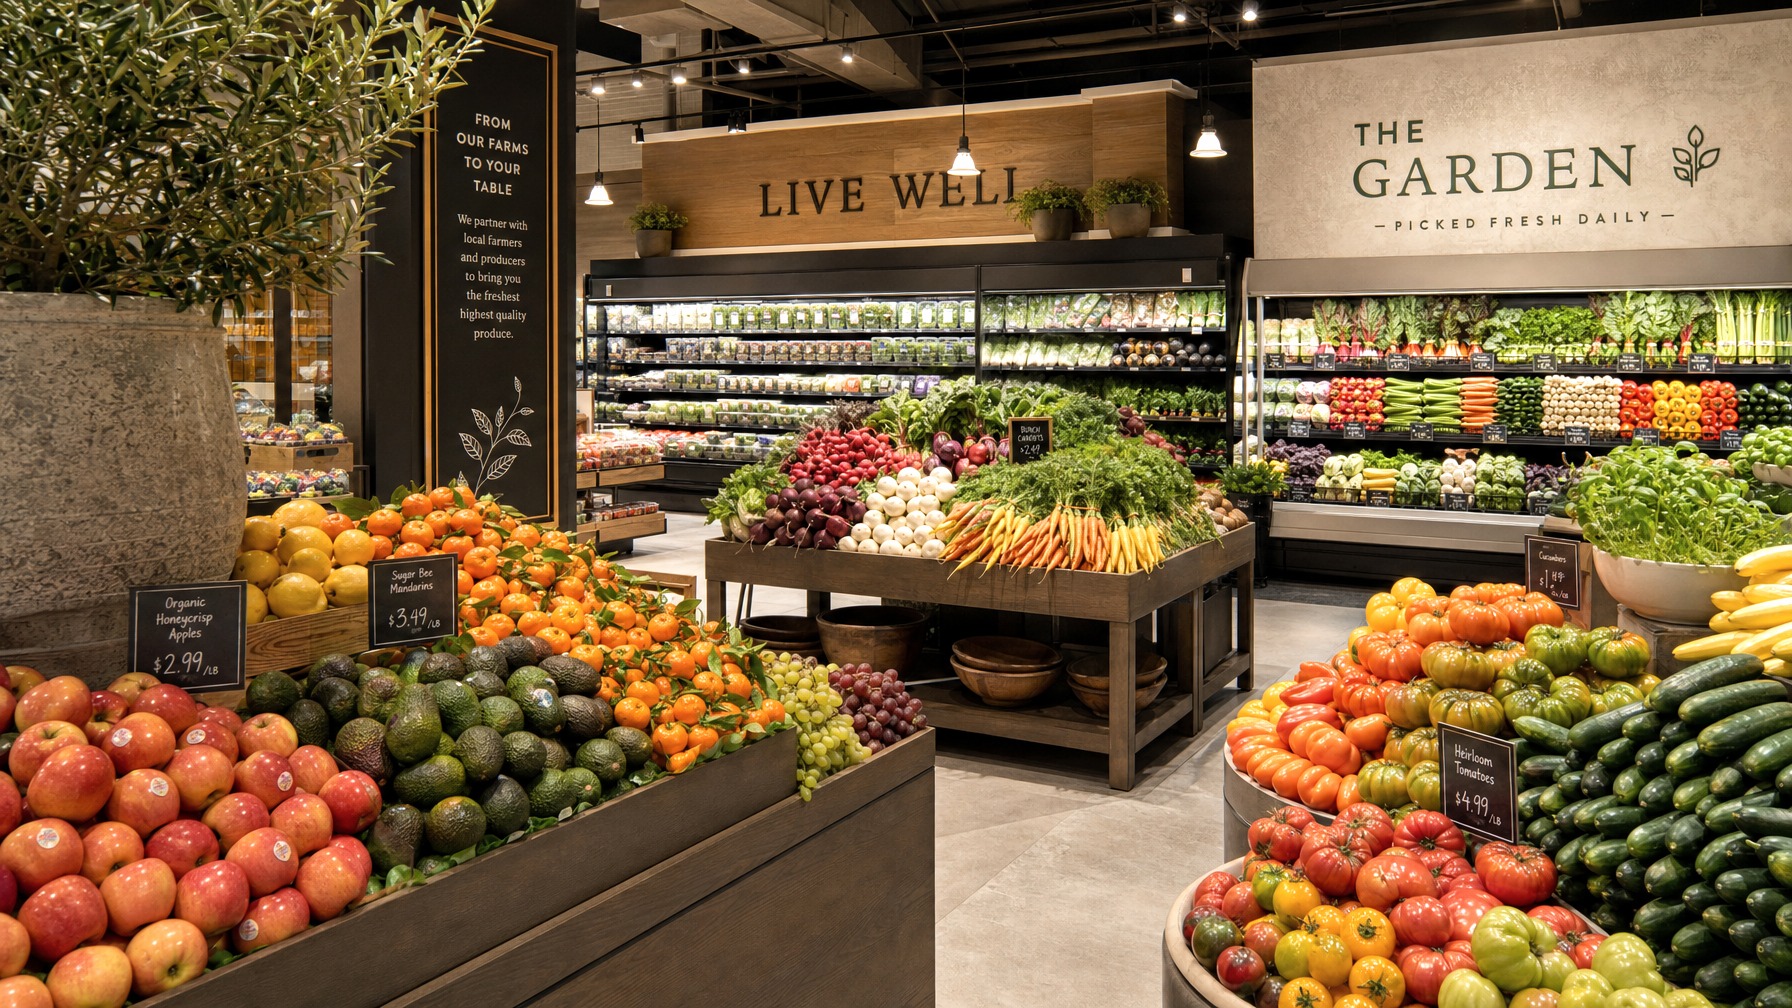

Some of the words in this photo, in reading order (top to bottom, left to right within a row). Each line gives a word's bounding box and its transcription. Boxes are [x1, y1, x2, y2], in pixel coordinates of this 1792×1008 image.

[475, 113, 511, 131] FROM
[1354, 119, 1424, 146] THE
[456, 132, 484, 148] OUR
[488, 138, 529, 155] FARMS
[464, 156, 482, 169] TO
[486, 159, 521, 175] YOUR
[1352, 144, 1637, 199] GARDEN
[473, 180, 512, 196] TABLE
[759, 177, 865, 217] LIVE
[457, 213, 472, 225] We
[474, 218, 507, 229] partner
[509, 220, 528, 231] with
[1395, 218, 1476, 232] PICKED
[1490, 215, 1562, 228] FRESH
[1578, 210, 1650, 225] DAILY
[463, 232, 486, 245] local
[488, 235, 522, 248] farmers
[460, 252, 478, 263] and
[481, 254, 526, 266] producers
[465, 272, 475, 281] to
[478, 271, 502, 285] bring
[504, 275, 521, 286] you
[466, 289, 482, 300] the
[484, 290, 520, 302] freshest
[460, 308, 493, 322] highest
[496, 309, 527, 323] quality
[474, 328, 514, 341] produce.
[391, 570, 416, 584] Sugar
[418, 567, 434, 578] Bee
[389, 581, 434, 595] Mandarins
[165, 596, 206, 613] Organic
[155, 612, 213, 629] Honeycrisp
[168, 628, 202, 644] Apples
[1454, 743, 1493, 768] Heirloom
[1454, 760, 1495, 786] Tomatoes
